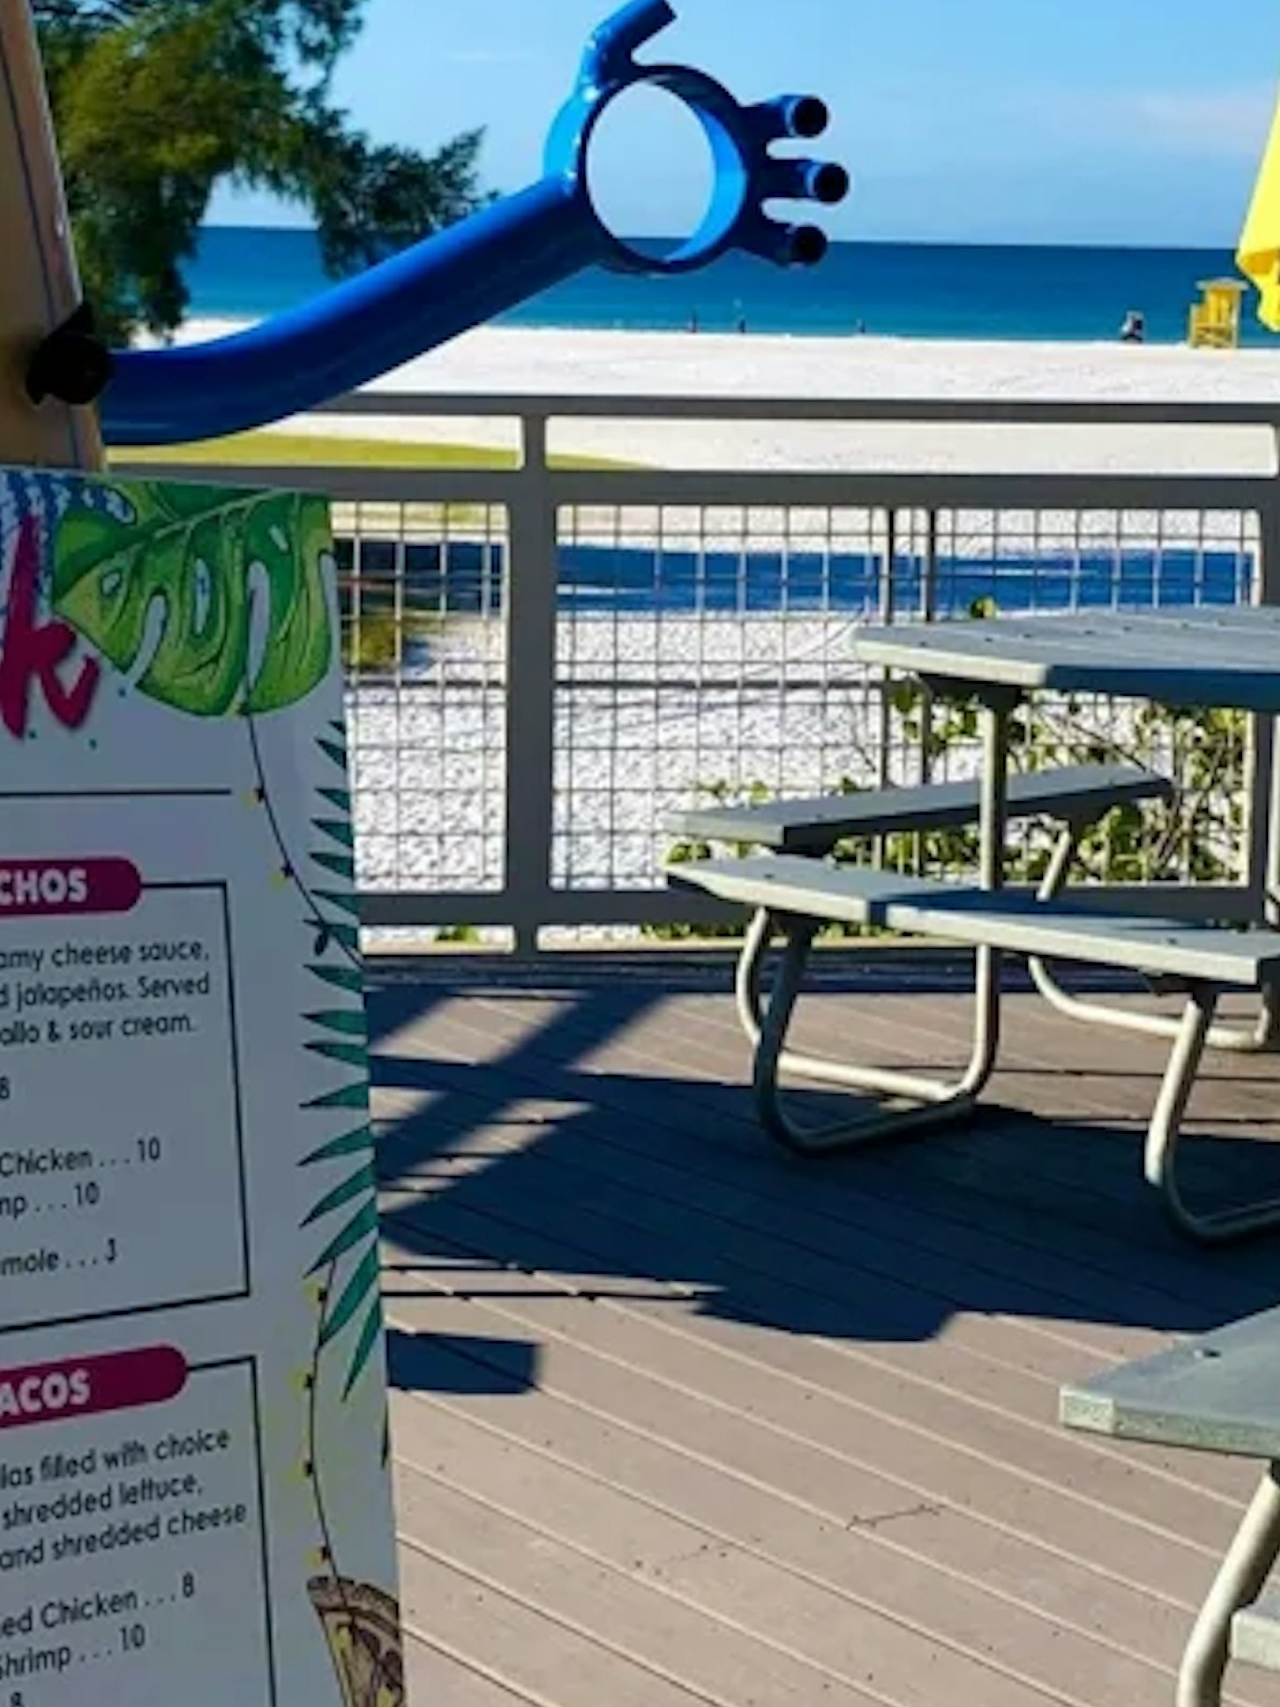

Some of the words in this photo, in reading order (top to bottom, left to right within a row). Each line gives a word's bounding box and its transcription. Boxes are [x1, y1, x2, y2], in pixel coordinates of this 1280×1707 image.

[51, 942, 133, 968] cheese
[137, 1136, 161, 1162] 10
[74, 1181, 100, 1207] 10
[105, 1238, 117, 1264] 3
[40, 1590, 138, 1629] Chicken
[182, 1572, 195, 1598] 8
[119, 1623, 145, 1651] 10
